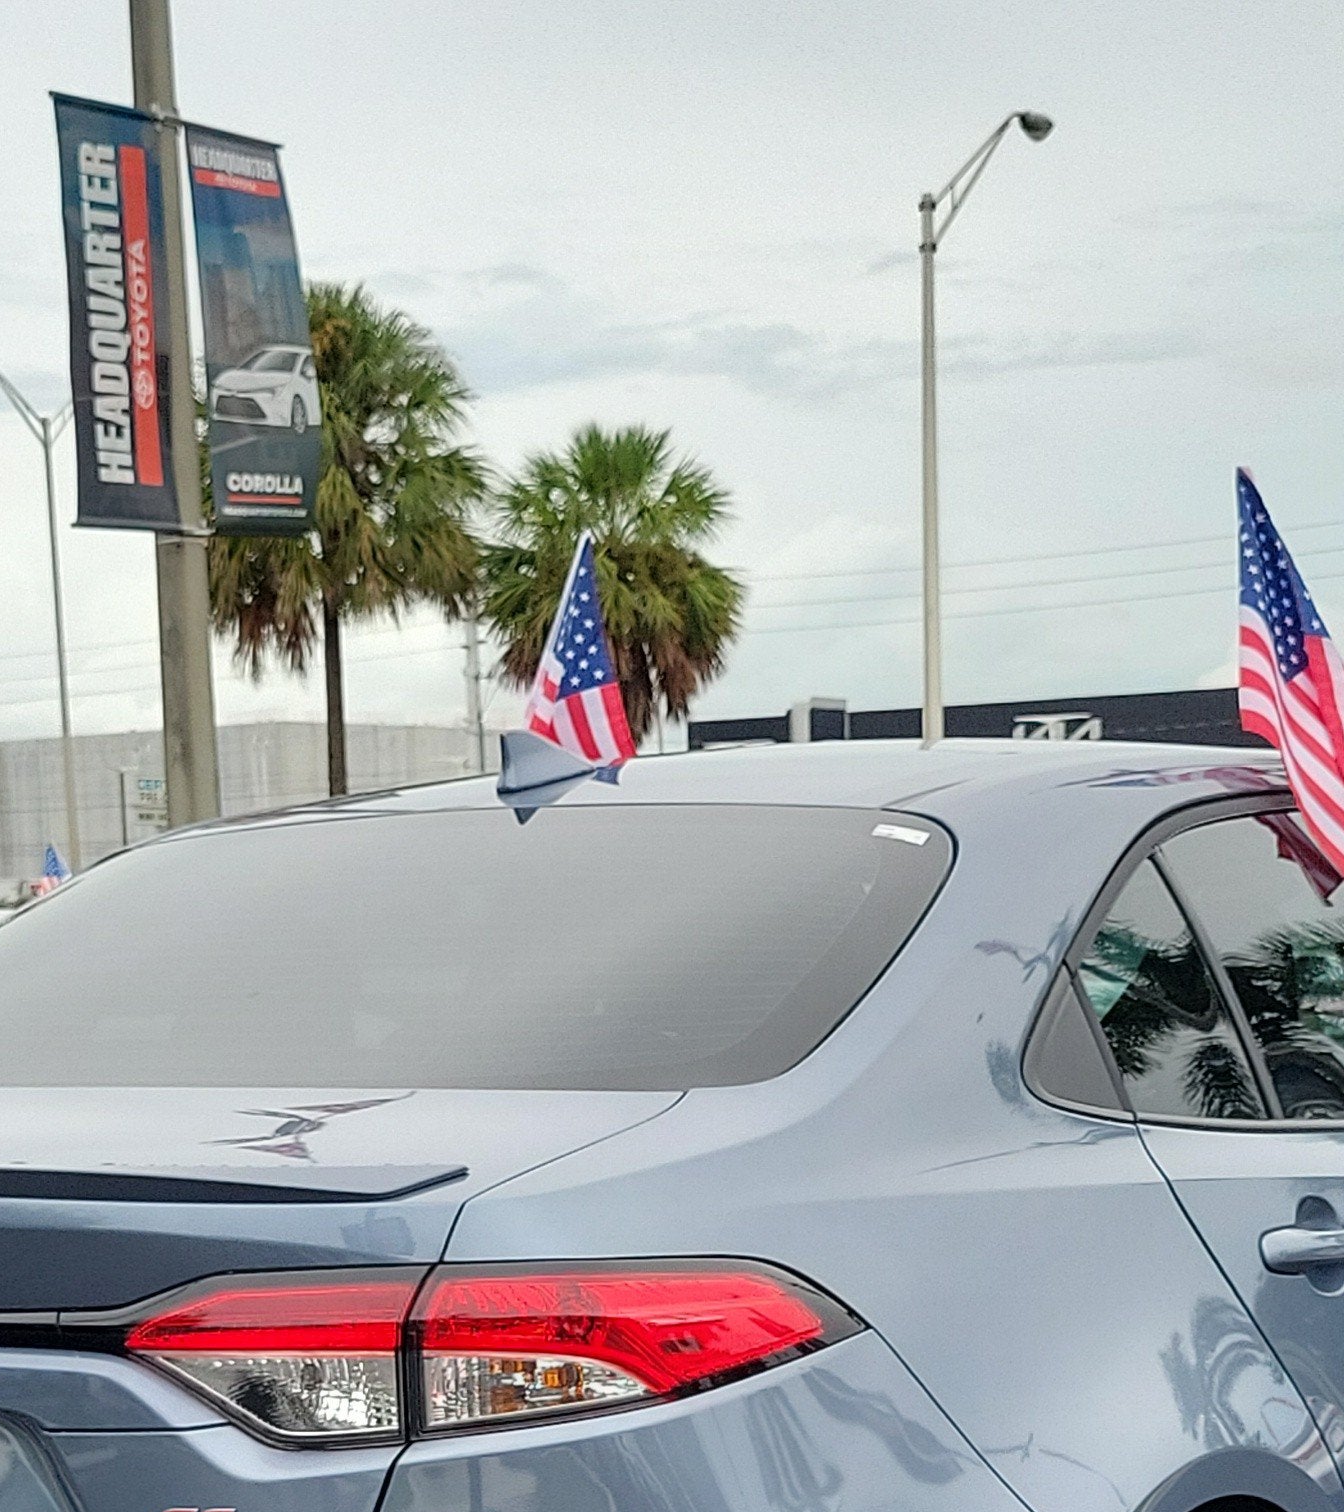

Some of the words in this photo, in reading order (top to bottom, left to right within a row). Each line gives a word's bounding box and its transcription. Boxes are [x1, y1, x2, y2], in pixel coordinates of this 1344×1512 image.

[79, 142, 136, 485] HEADQUARTER
[127, 239, 151, 364] TOYOTA
[226, 472, 304, 495] COROLLA
